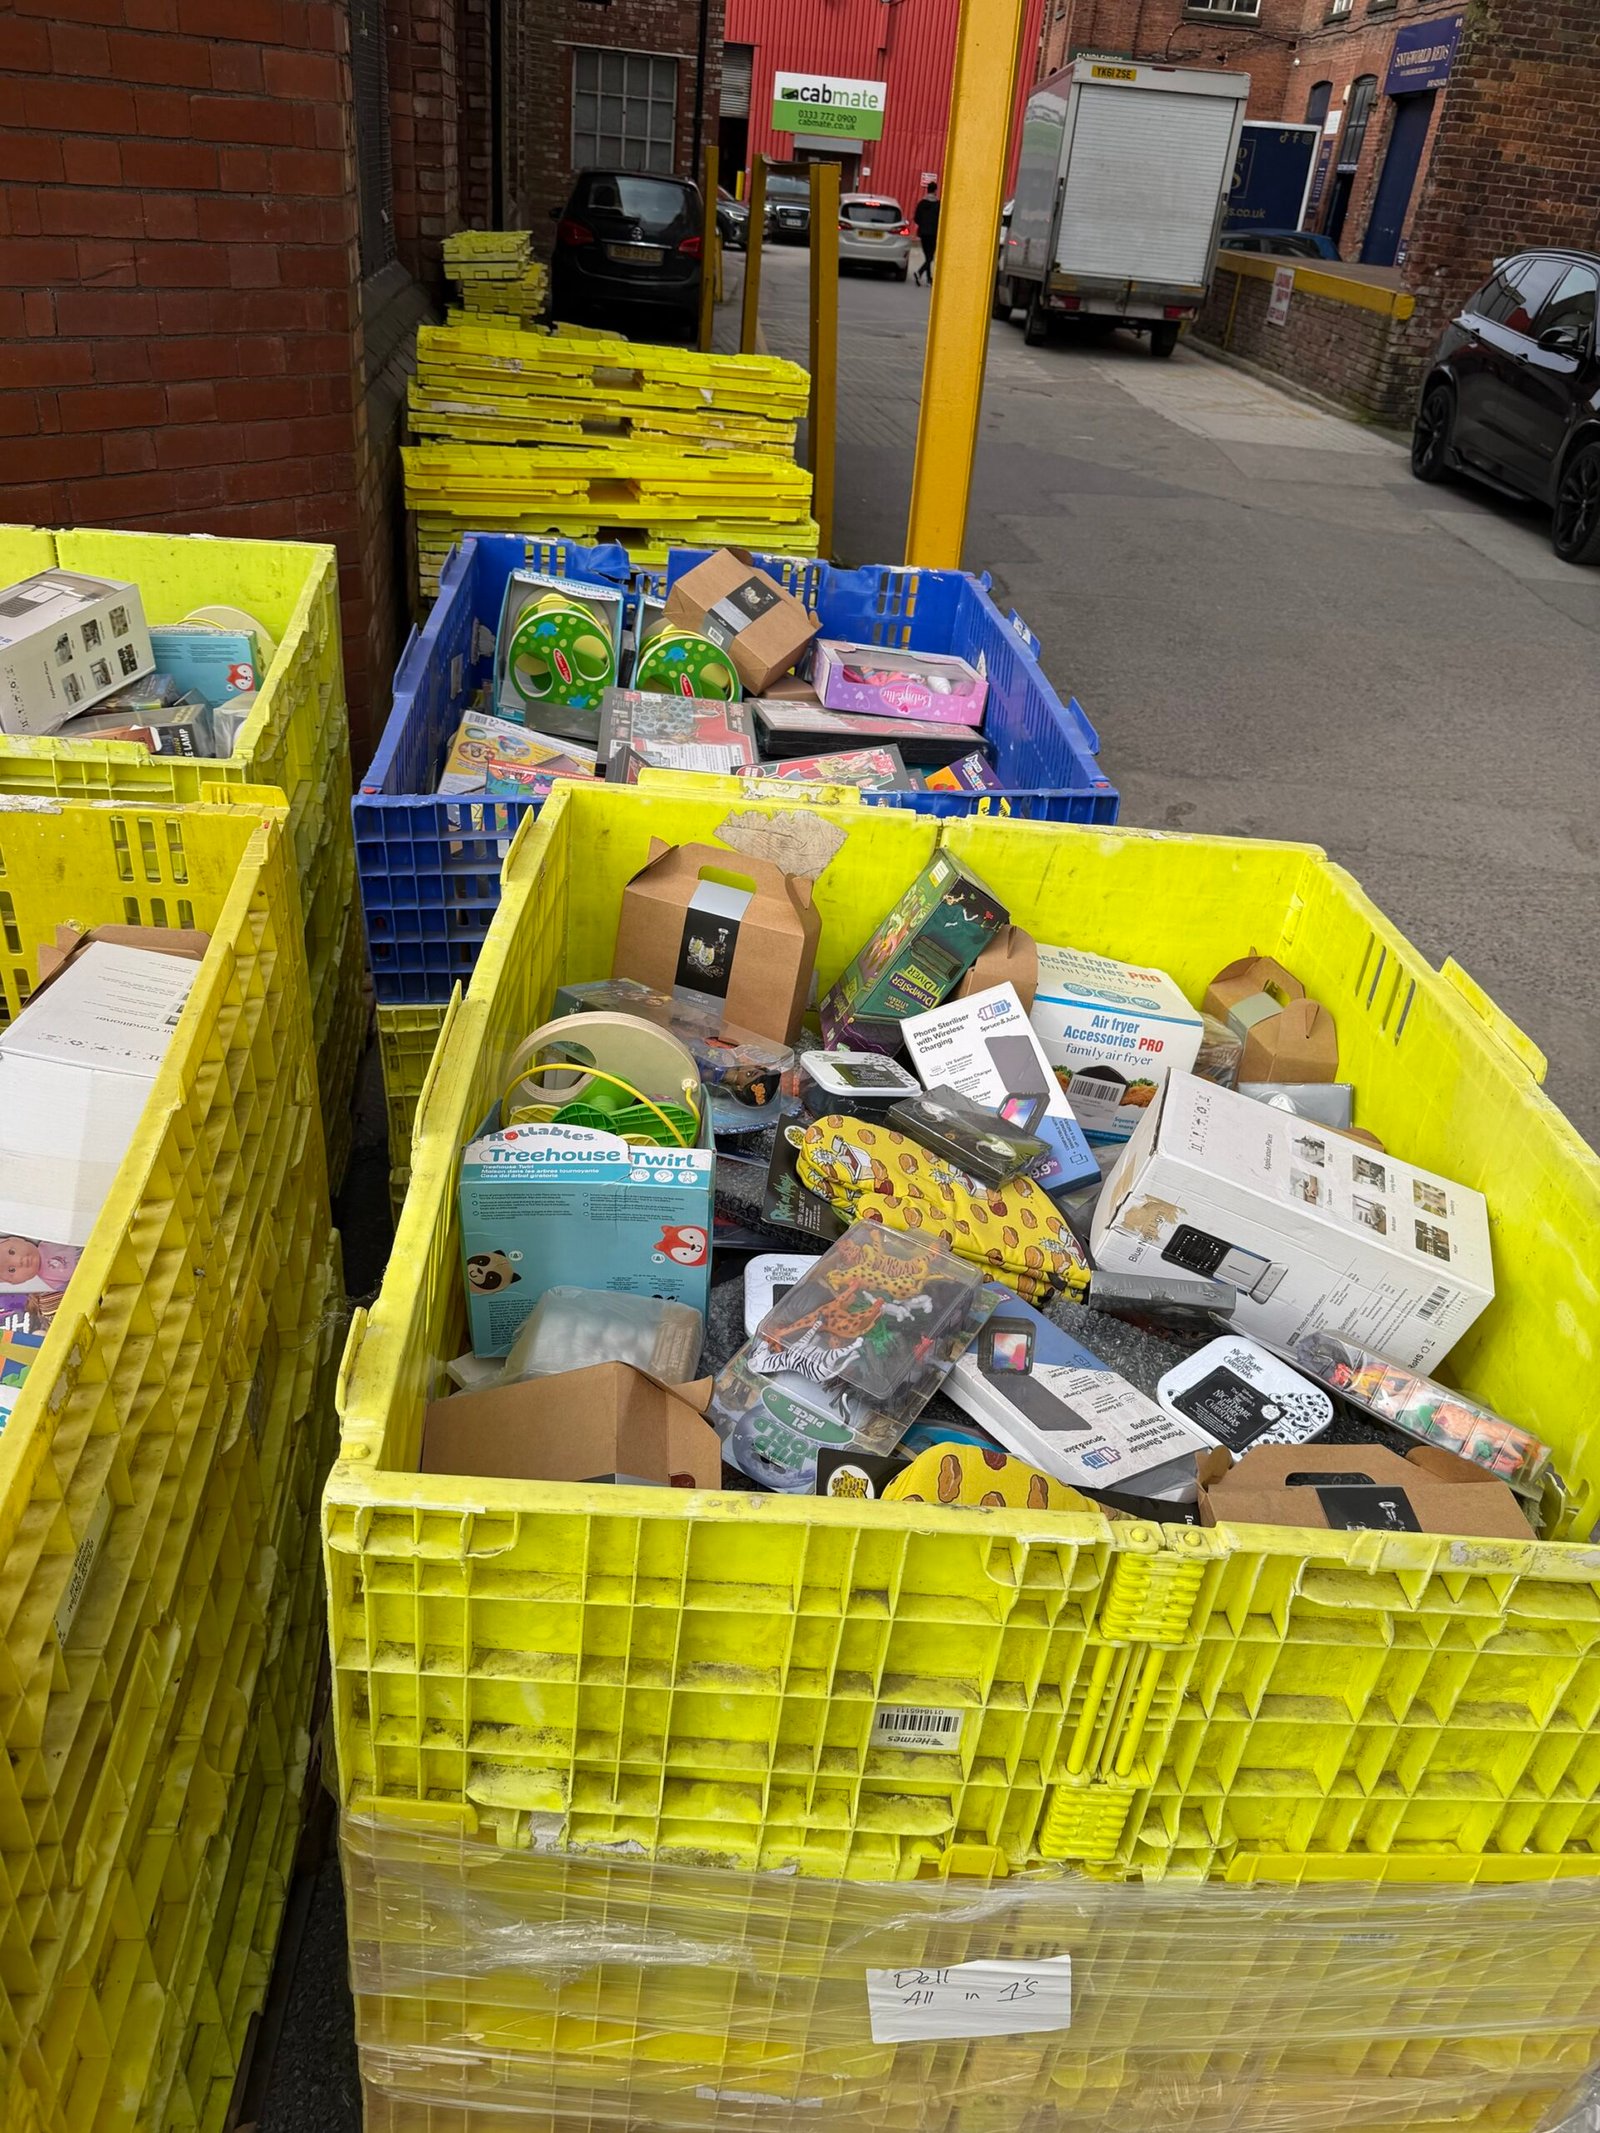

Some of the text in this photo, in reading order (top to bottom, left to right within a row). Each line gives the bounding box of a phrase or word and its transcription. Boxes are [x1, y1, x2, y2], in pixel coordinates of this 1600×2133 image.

[800, 83, 879, 108] cabmate
[798, 109, 858, 124] 0333 772 0900
[798, 118, 856, 131] cabmate.co.uk
[1058, 951, 1119, 970] Air fryer
[907, 966, 936, 990] DIVER
[1127, 971, 1162, 984] PRO
[891, 975, 936, 1007] DUMPSTER
[913, 1013, 970, 1040] Phone Steriliser
[1091, 1015, 1141, 1035] Air fryer
[916, 1024, 965, 1047] with Wireless
[919, 1037, 954, 1054] Charging
[1063, 1025, 1164, 1053] Accessories PRO
[1066, 1043, 1102, 1061] family
[1123, 1052, 1153, 1066] fryer
[489, 1148, 695, 1167] Treehouse Twirl
[1128, 1246, 1144, 1263] Blue
[787, 1403, 826, 1429] PIECES
[791, 1418, 809, 1431] 21
[1130, 1414, 1167, 1431] Charging
[1126, 1421, 1176, 1445] with Wireless
[1128, 1428, 1186, 1455] Phone Steriliser
[754, 1435, 805, 1470] WILD
[888, 1735, 931, 1745] Hermes
[893, 1968, 950, 1989] Dell
[903, 1990, 934, 2005] All
[965, 1992, 980, 2001] in
